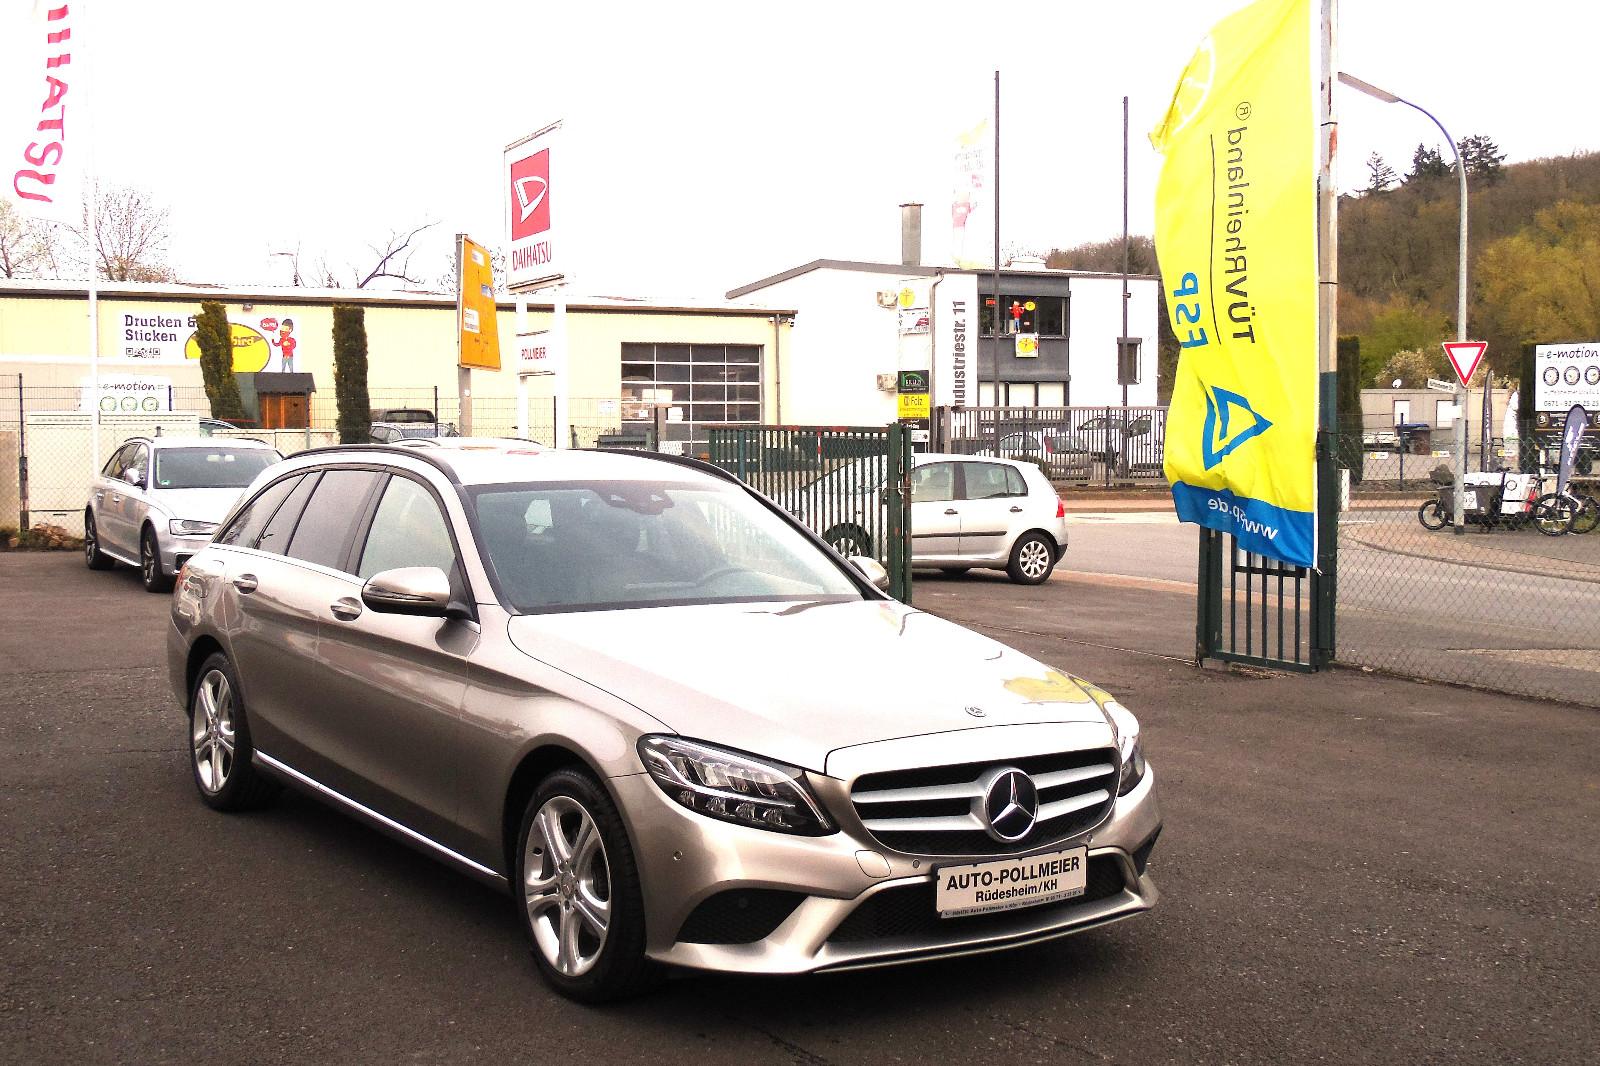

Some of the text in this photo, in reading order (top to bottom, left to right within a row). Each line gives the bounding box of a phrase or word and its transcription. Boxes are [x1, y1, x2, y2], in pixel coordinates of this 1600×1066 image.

[512, 240, 552, 272] DAIHATSU
[124, 314, 182, 328] Drucken
[125, 329, 177, 342] Sticken
[952, 301, 966, 407] ndustriestr. 11
[1546, 346, 1599, 359] e-motion
[102, 380, 156, 391] e-motion
[946, 856, 1080, 891] AUTO-POLLMEIER
[975, 879, 1058, 902] Rüdesheim/KH
